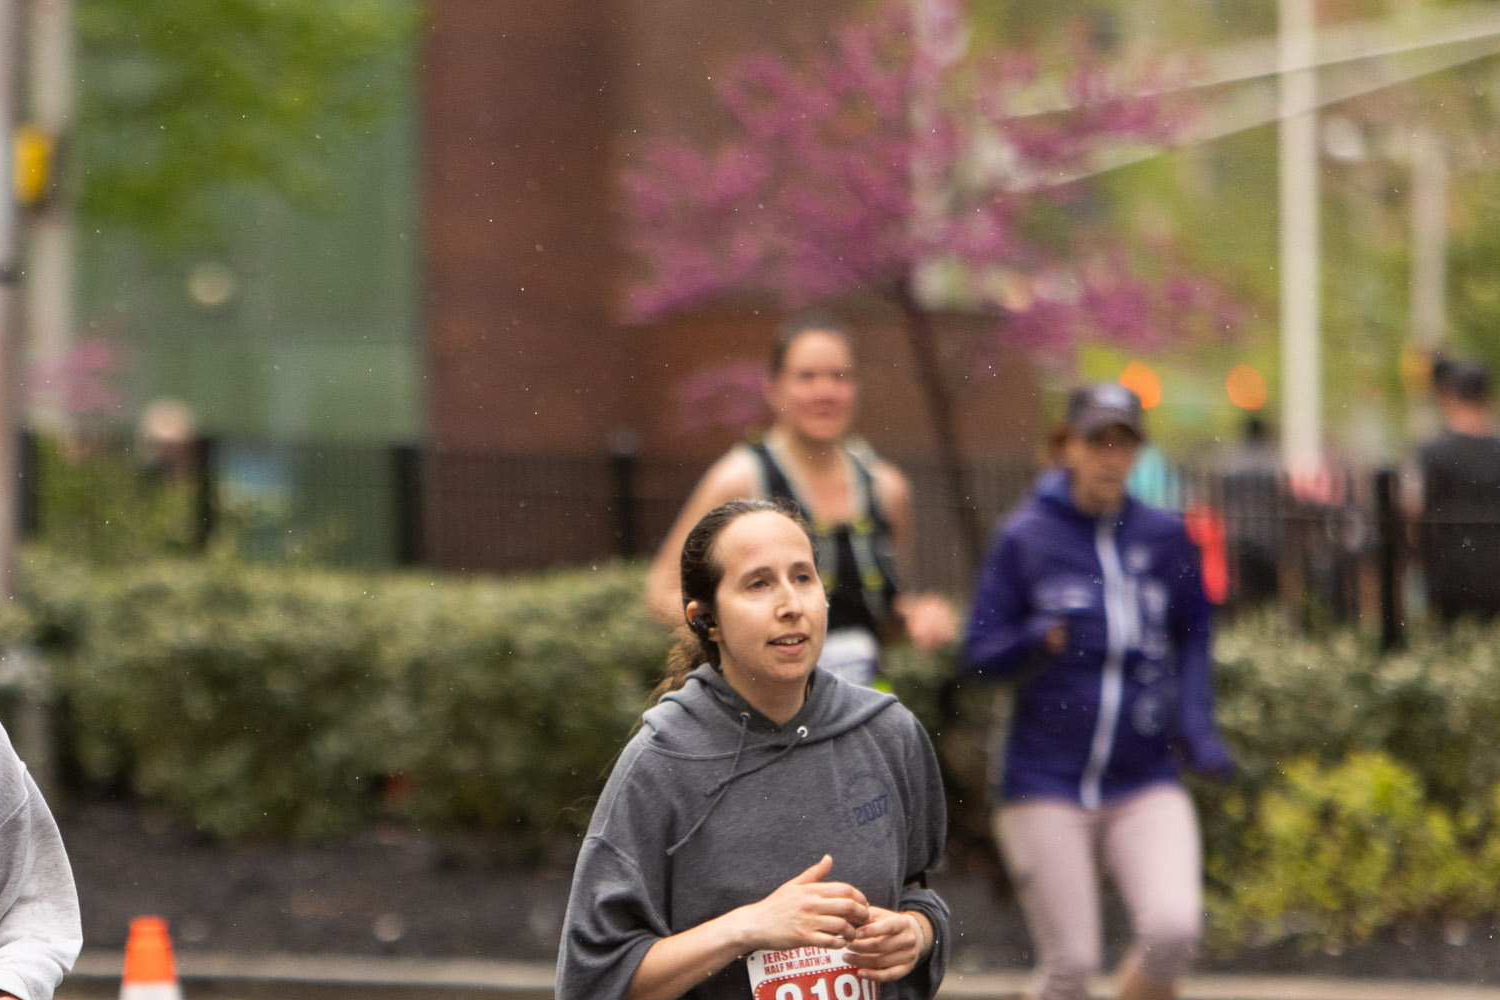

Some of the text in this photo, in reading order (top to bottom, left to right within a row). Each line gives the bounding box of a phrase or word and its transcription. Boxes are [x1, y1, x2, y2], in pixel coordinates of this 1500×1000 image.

[852, 794, 888, 827] 2007
[763, 947, 801, 965] JERSEY
[764, 963, 785, 976] HALF
